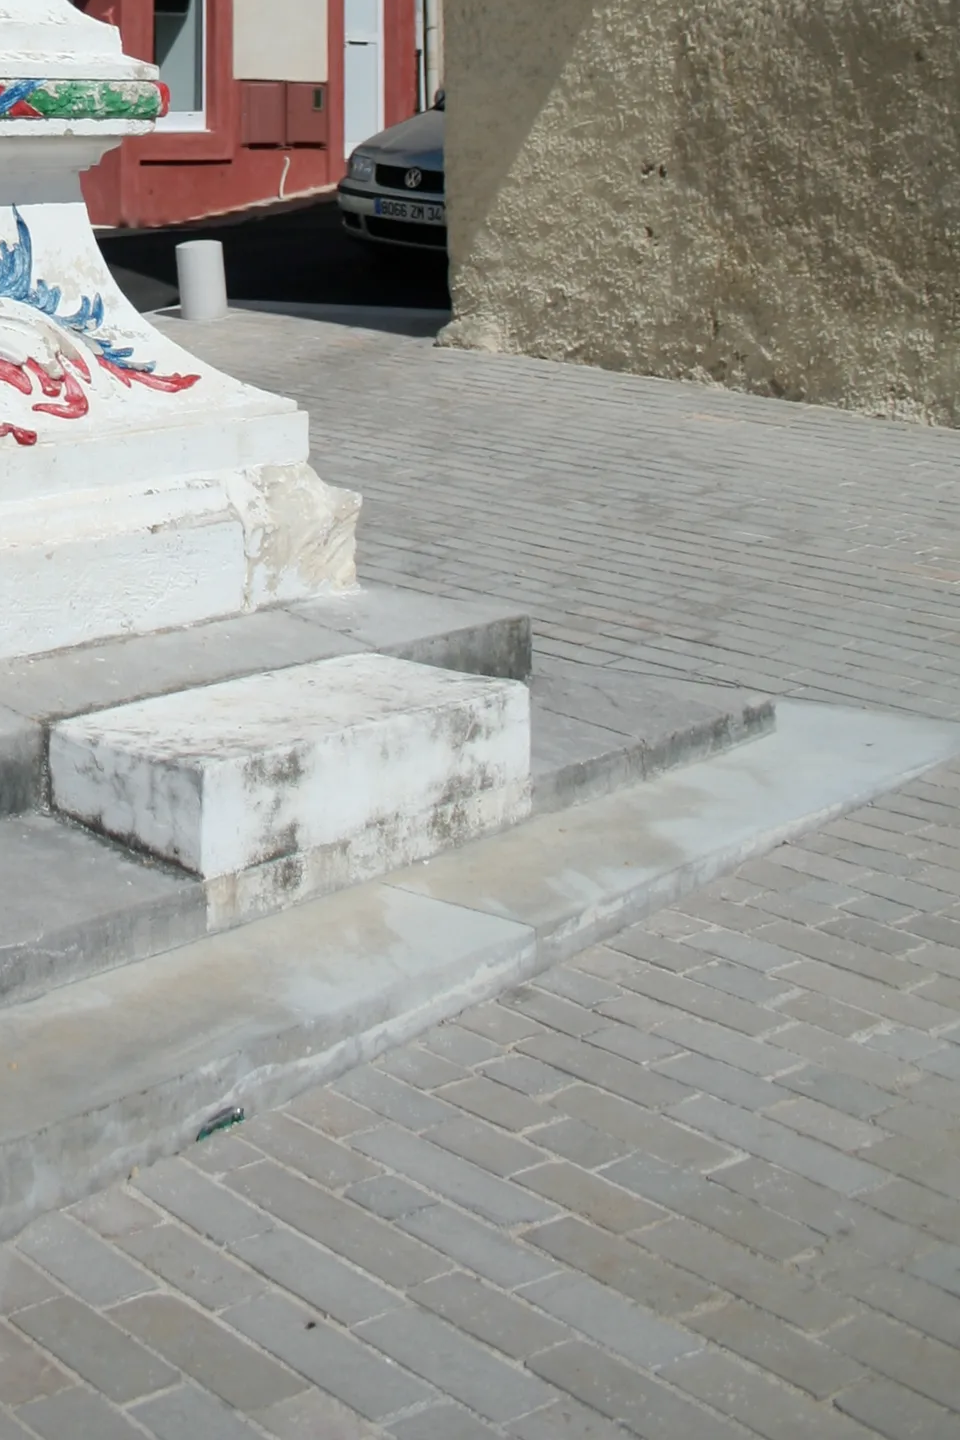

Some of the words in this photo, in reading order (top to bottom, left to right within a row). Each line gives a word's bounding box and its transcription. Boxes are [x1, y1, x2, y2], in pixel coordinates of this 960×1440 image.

[382, 201, 407, 217] 8066
[410, 205, 425, 219] ZM
[427, 207, 442, 221] 34
